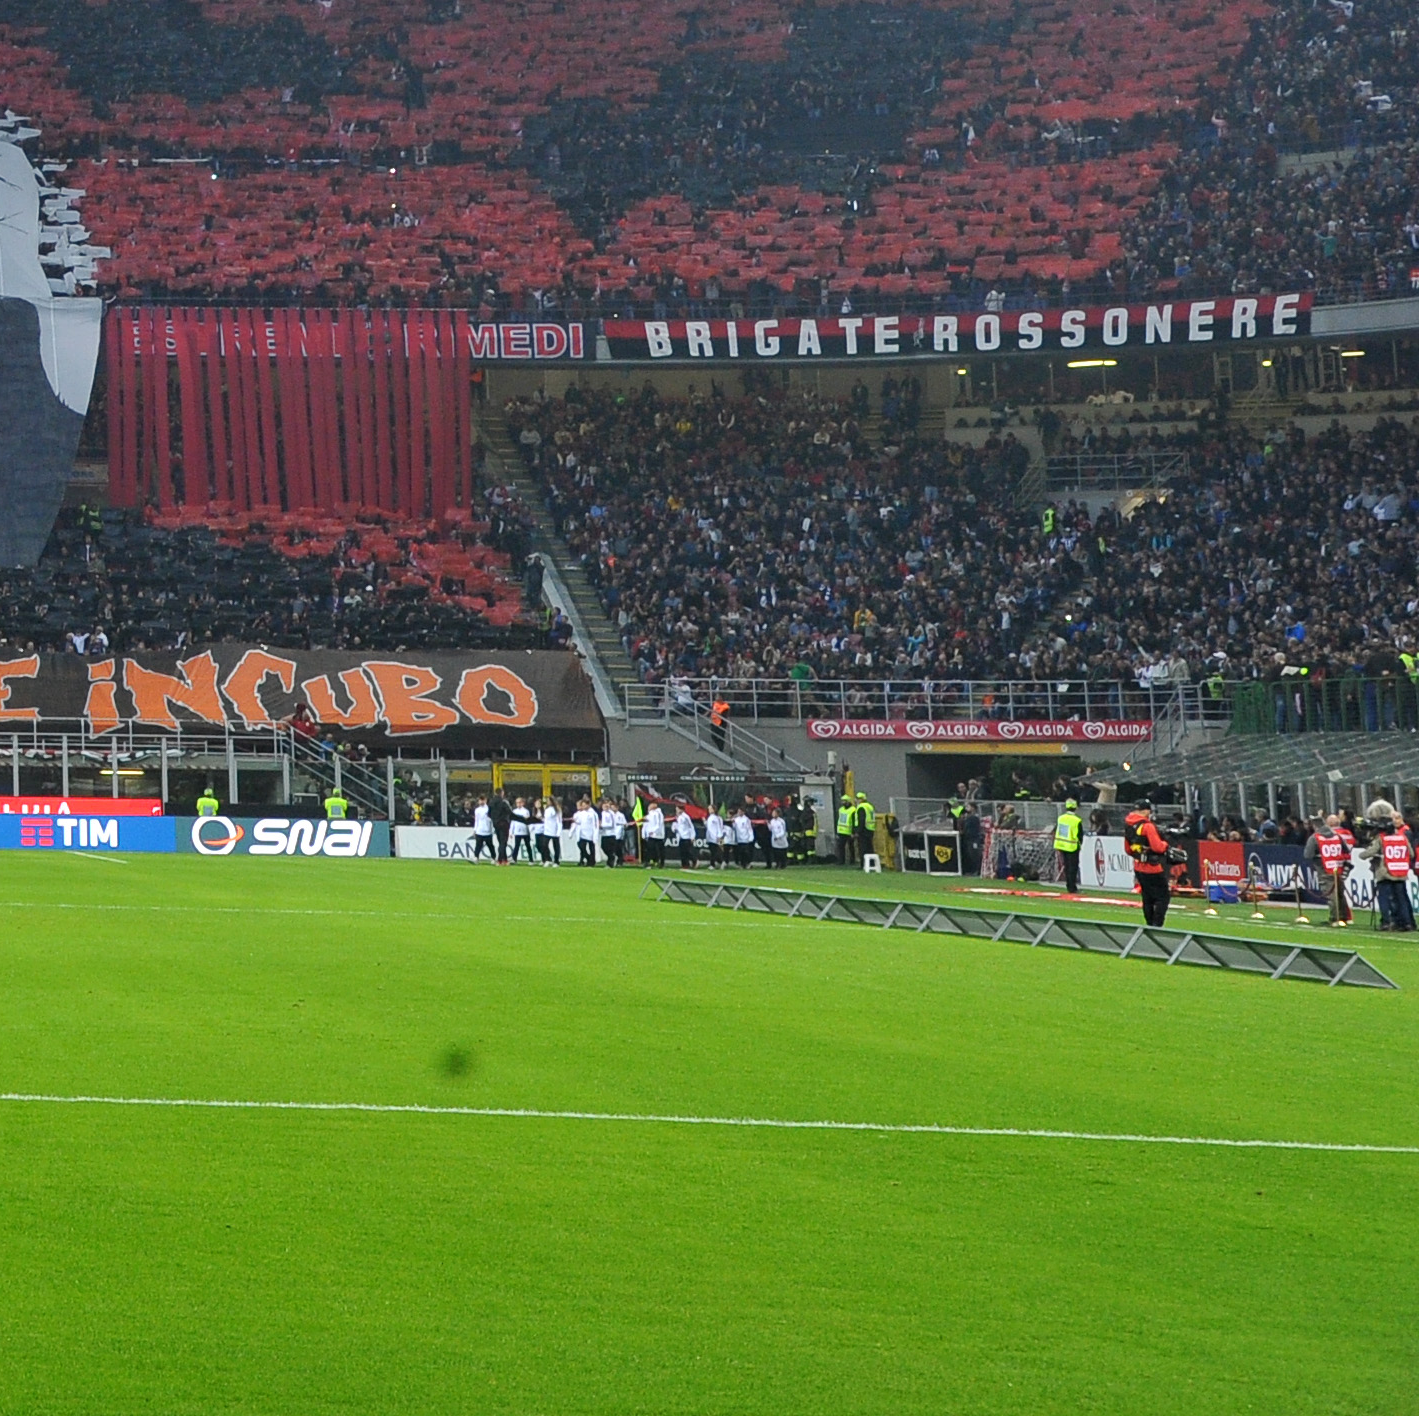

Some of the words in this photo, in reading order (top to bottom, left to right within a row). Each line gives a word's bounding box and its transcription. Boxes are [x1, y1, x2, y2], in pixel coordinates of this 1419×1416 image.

[648, 314, 900, 357] BRIGATE
[933, 293, 1301, 352] ROSSONERE
[842, 724, 893, 735] ALGIDA
[936, 725, 985, 736] ALGIDA
[1025, 725, 1072, 736] ALGIDA
[1107, 726, 1146, 736] ALGIDA
[57, 818, 119, 848] TIM
[1321, 843, 1343, 857] 097
